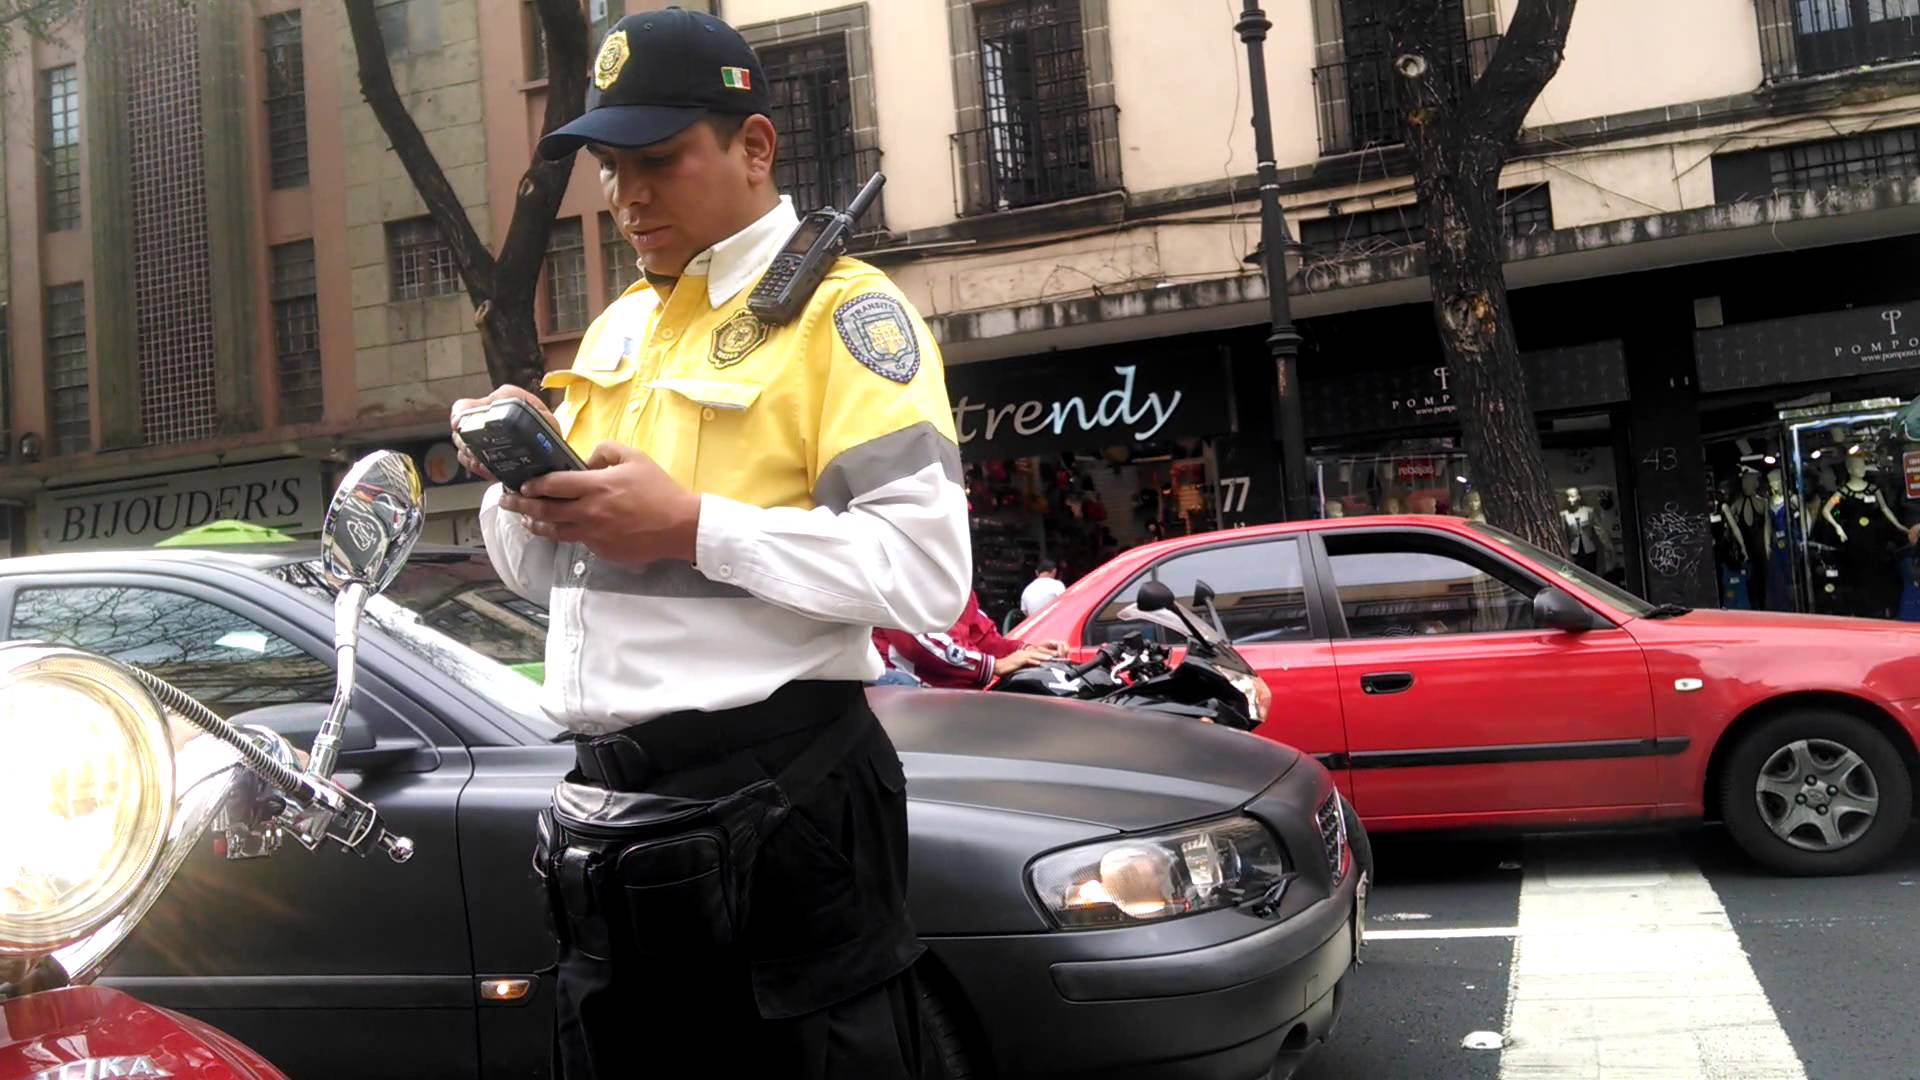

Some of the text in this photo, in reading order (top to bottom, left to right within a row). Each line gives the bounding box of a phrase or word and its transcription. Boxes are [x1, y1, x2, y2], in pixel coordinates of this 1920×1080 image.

[952, 364, 1183, 443] trendy
[60, 477, 301, 543] BIJOUDER'S
[1220, 477, 1250, 513] 77
